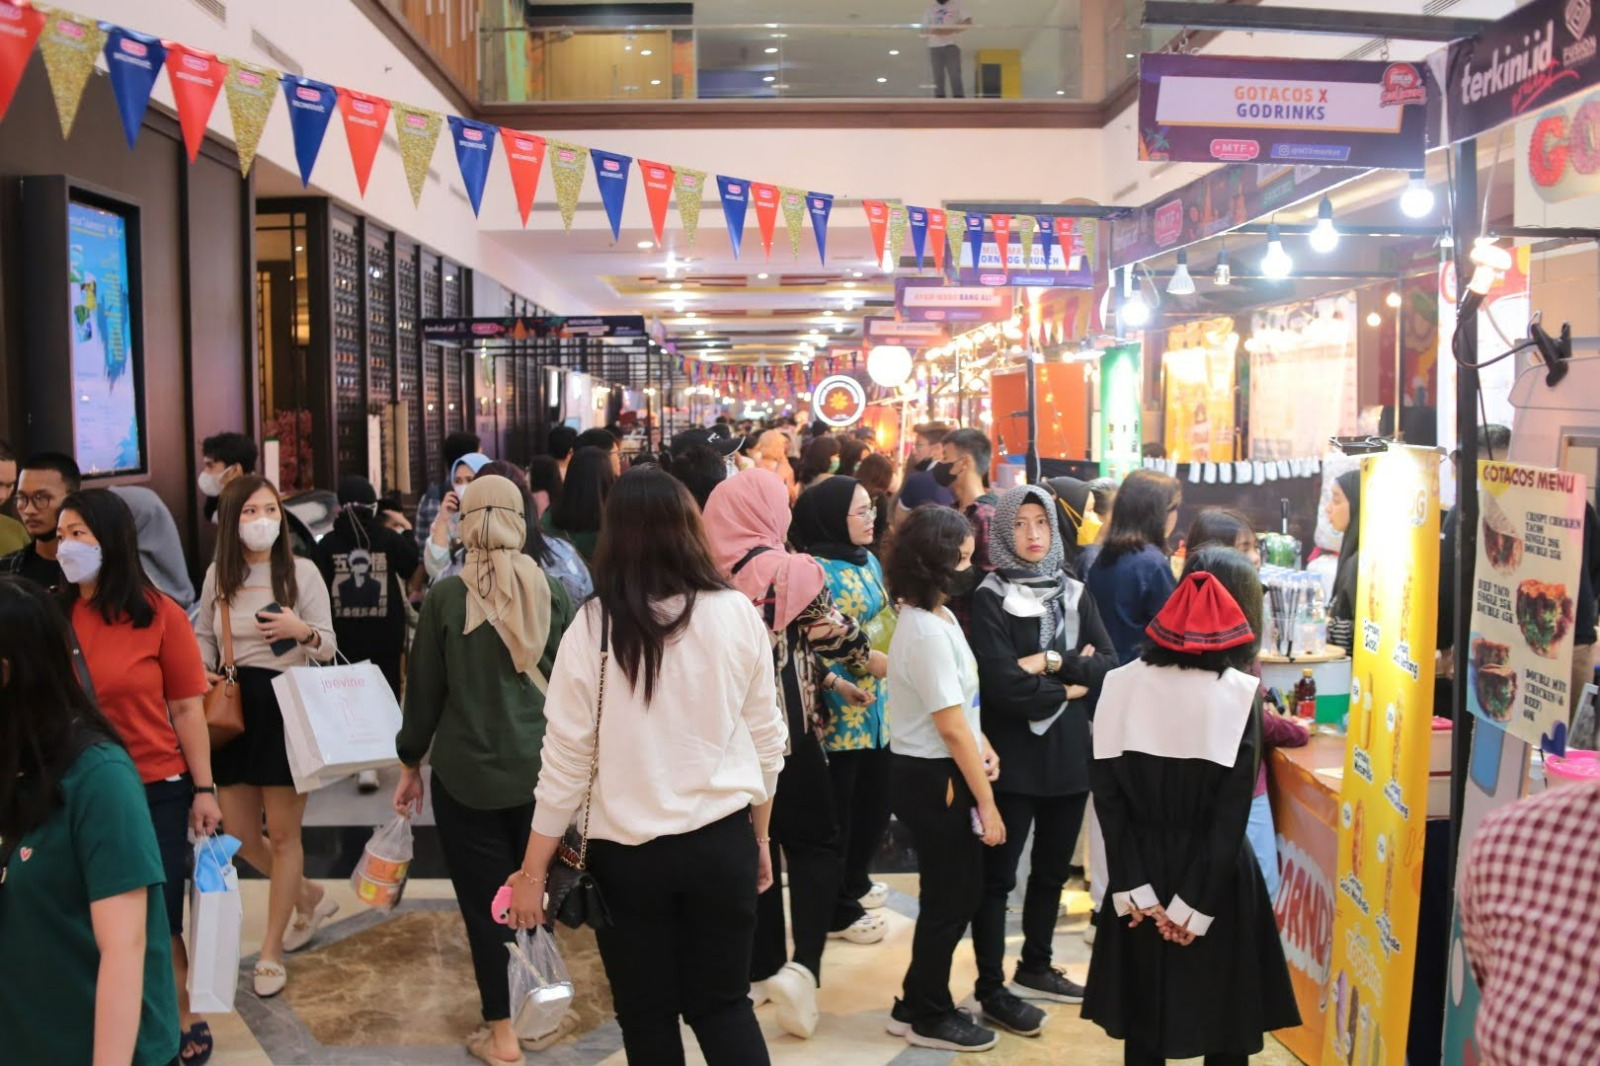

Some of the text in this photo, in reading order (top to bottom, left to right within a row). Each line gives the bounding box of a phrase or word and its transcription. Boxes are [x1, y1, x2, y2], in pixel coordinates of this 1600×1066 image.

[1461, 20, 1554, 105] terkini.id
[1234, 85, 1328, 103] GOTACOS X
[1236, 103, 1326, 120] GODRINKS
[1222, 144, 1248, 153] MTF
[1483, 465, 1575, 493] GOTACOS MENU
